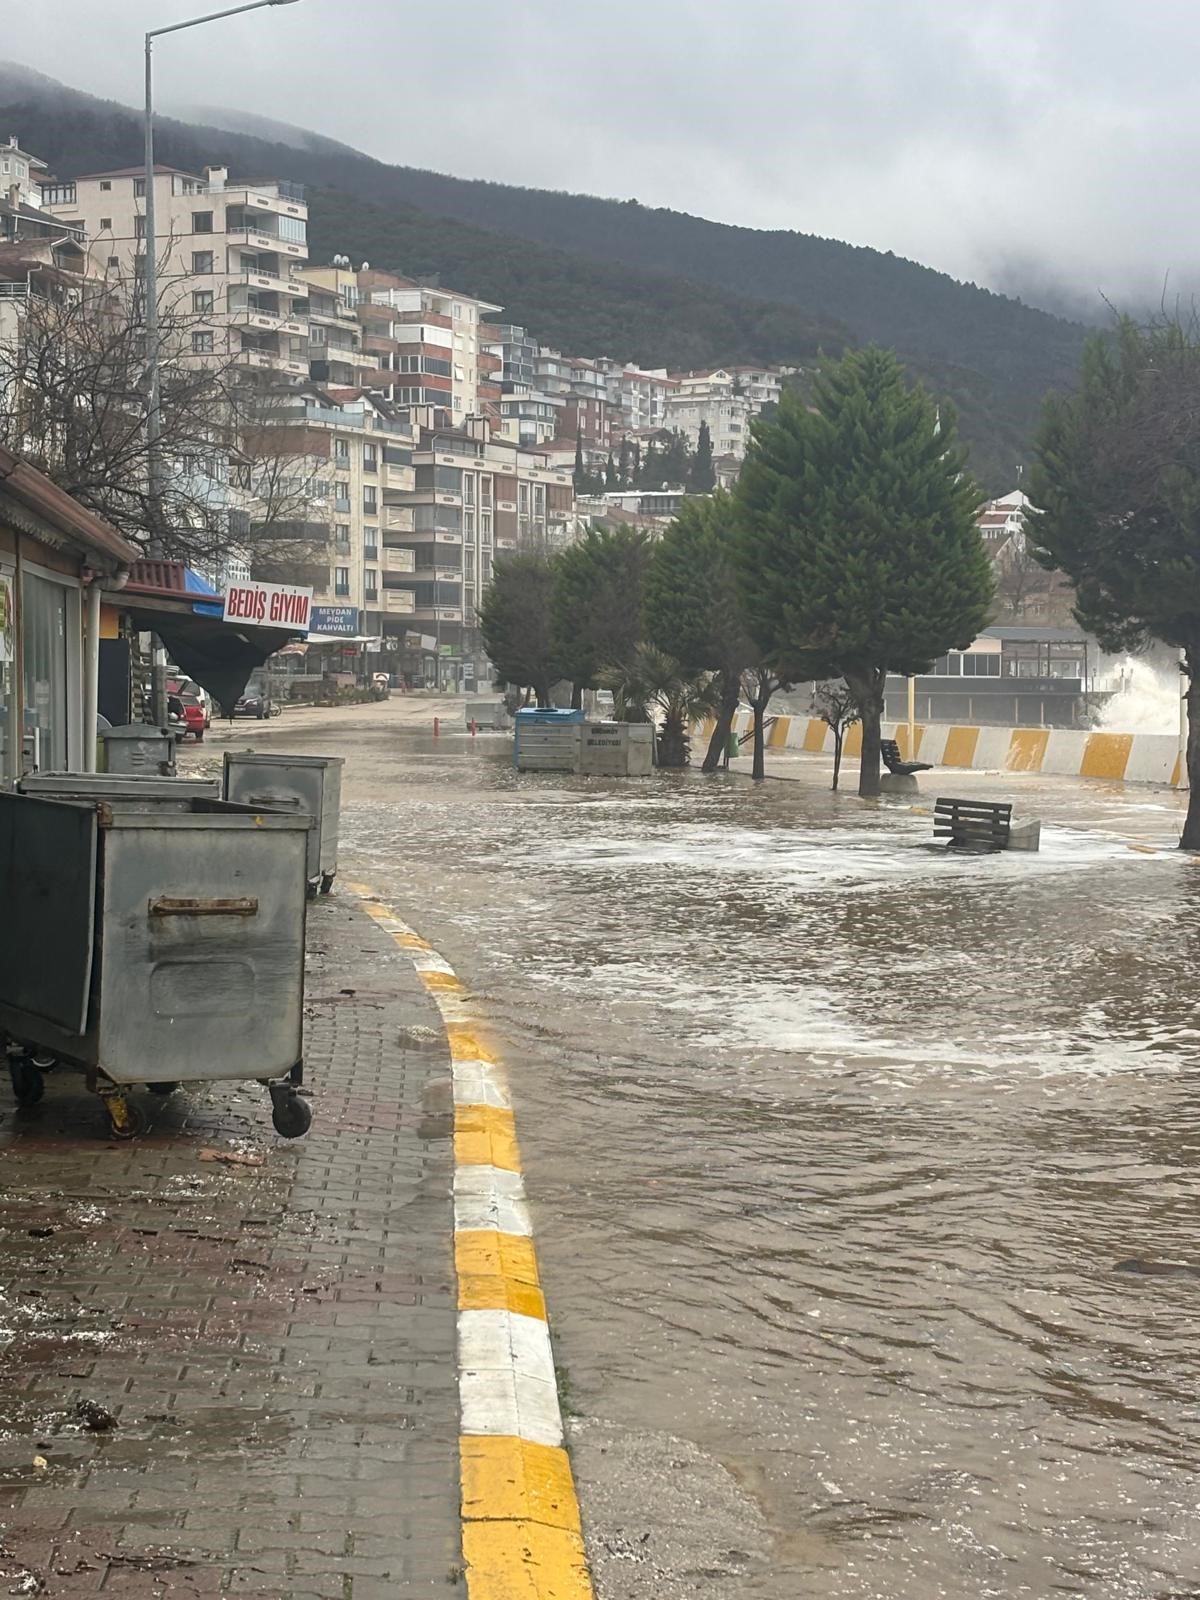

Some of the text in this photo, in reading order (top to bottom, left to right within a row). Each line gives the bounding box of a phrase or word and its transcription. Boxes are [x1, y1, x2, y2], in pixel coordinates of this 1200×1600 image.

[228, 585, 309, 624] BEDİŞ GİYİM
[319, 608, 352, 616] MEYDAN
[317, 624, 354, 632] KAHVALTI
